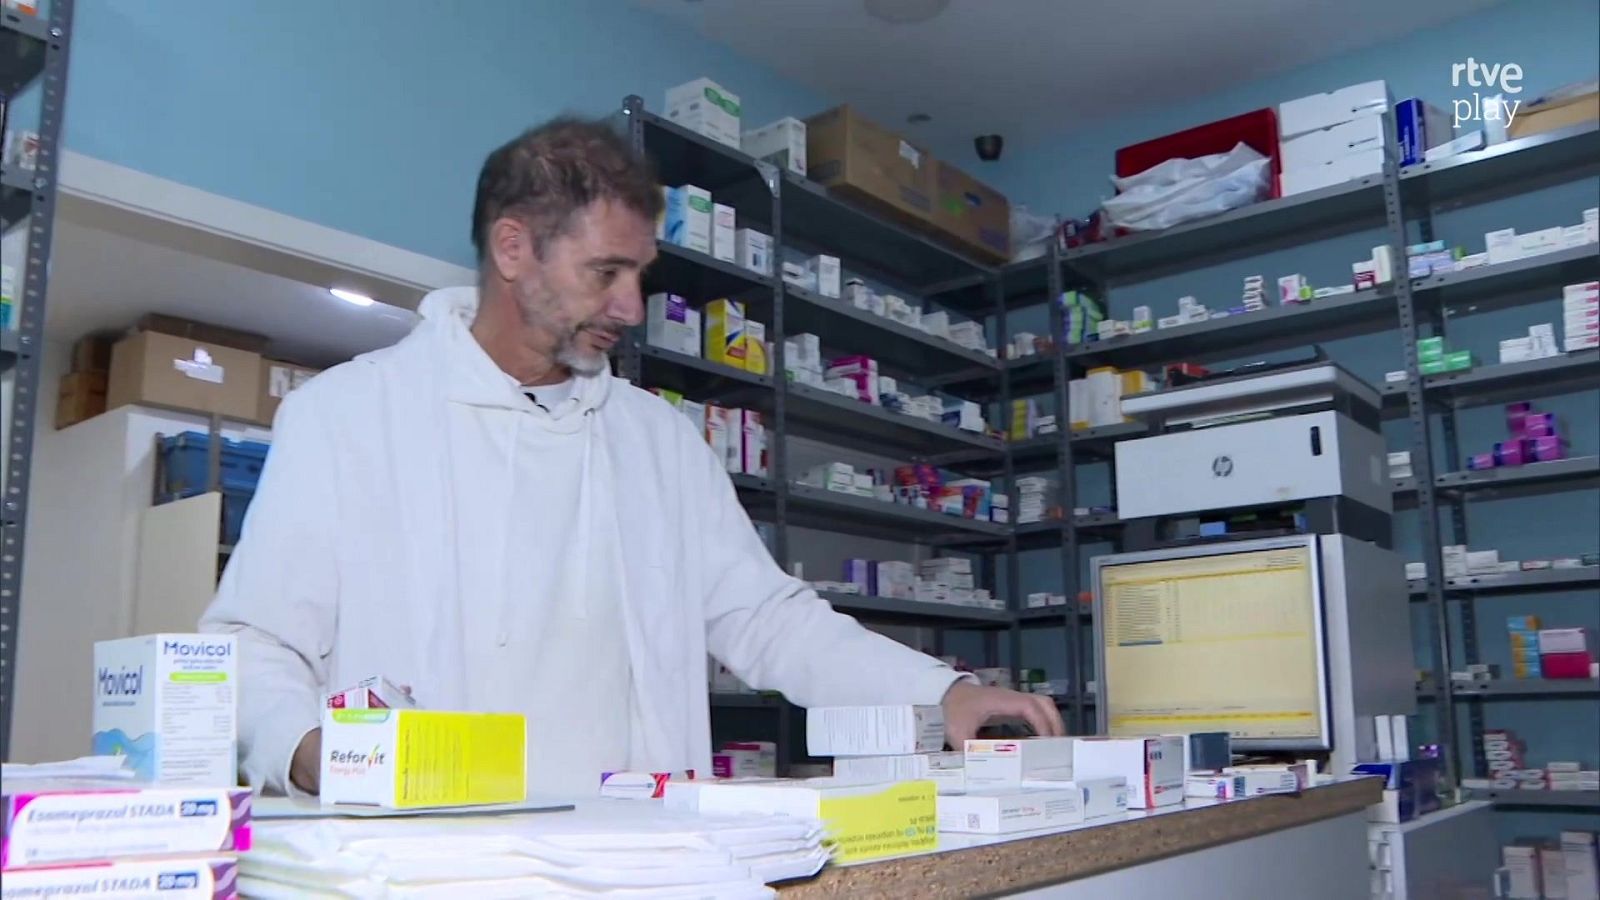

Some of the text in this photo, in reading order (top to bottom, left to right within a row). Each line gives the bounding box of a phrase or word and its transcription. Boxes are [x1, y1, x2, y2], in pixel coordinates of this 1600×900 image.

[163, 640, 231, 656] Movicol
[97, 665, 143, 695] Movicol
[129, 803, 175, 819] STADA
[101, 877, 151, 892] STADA
